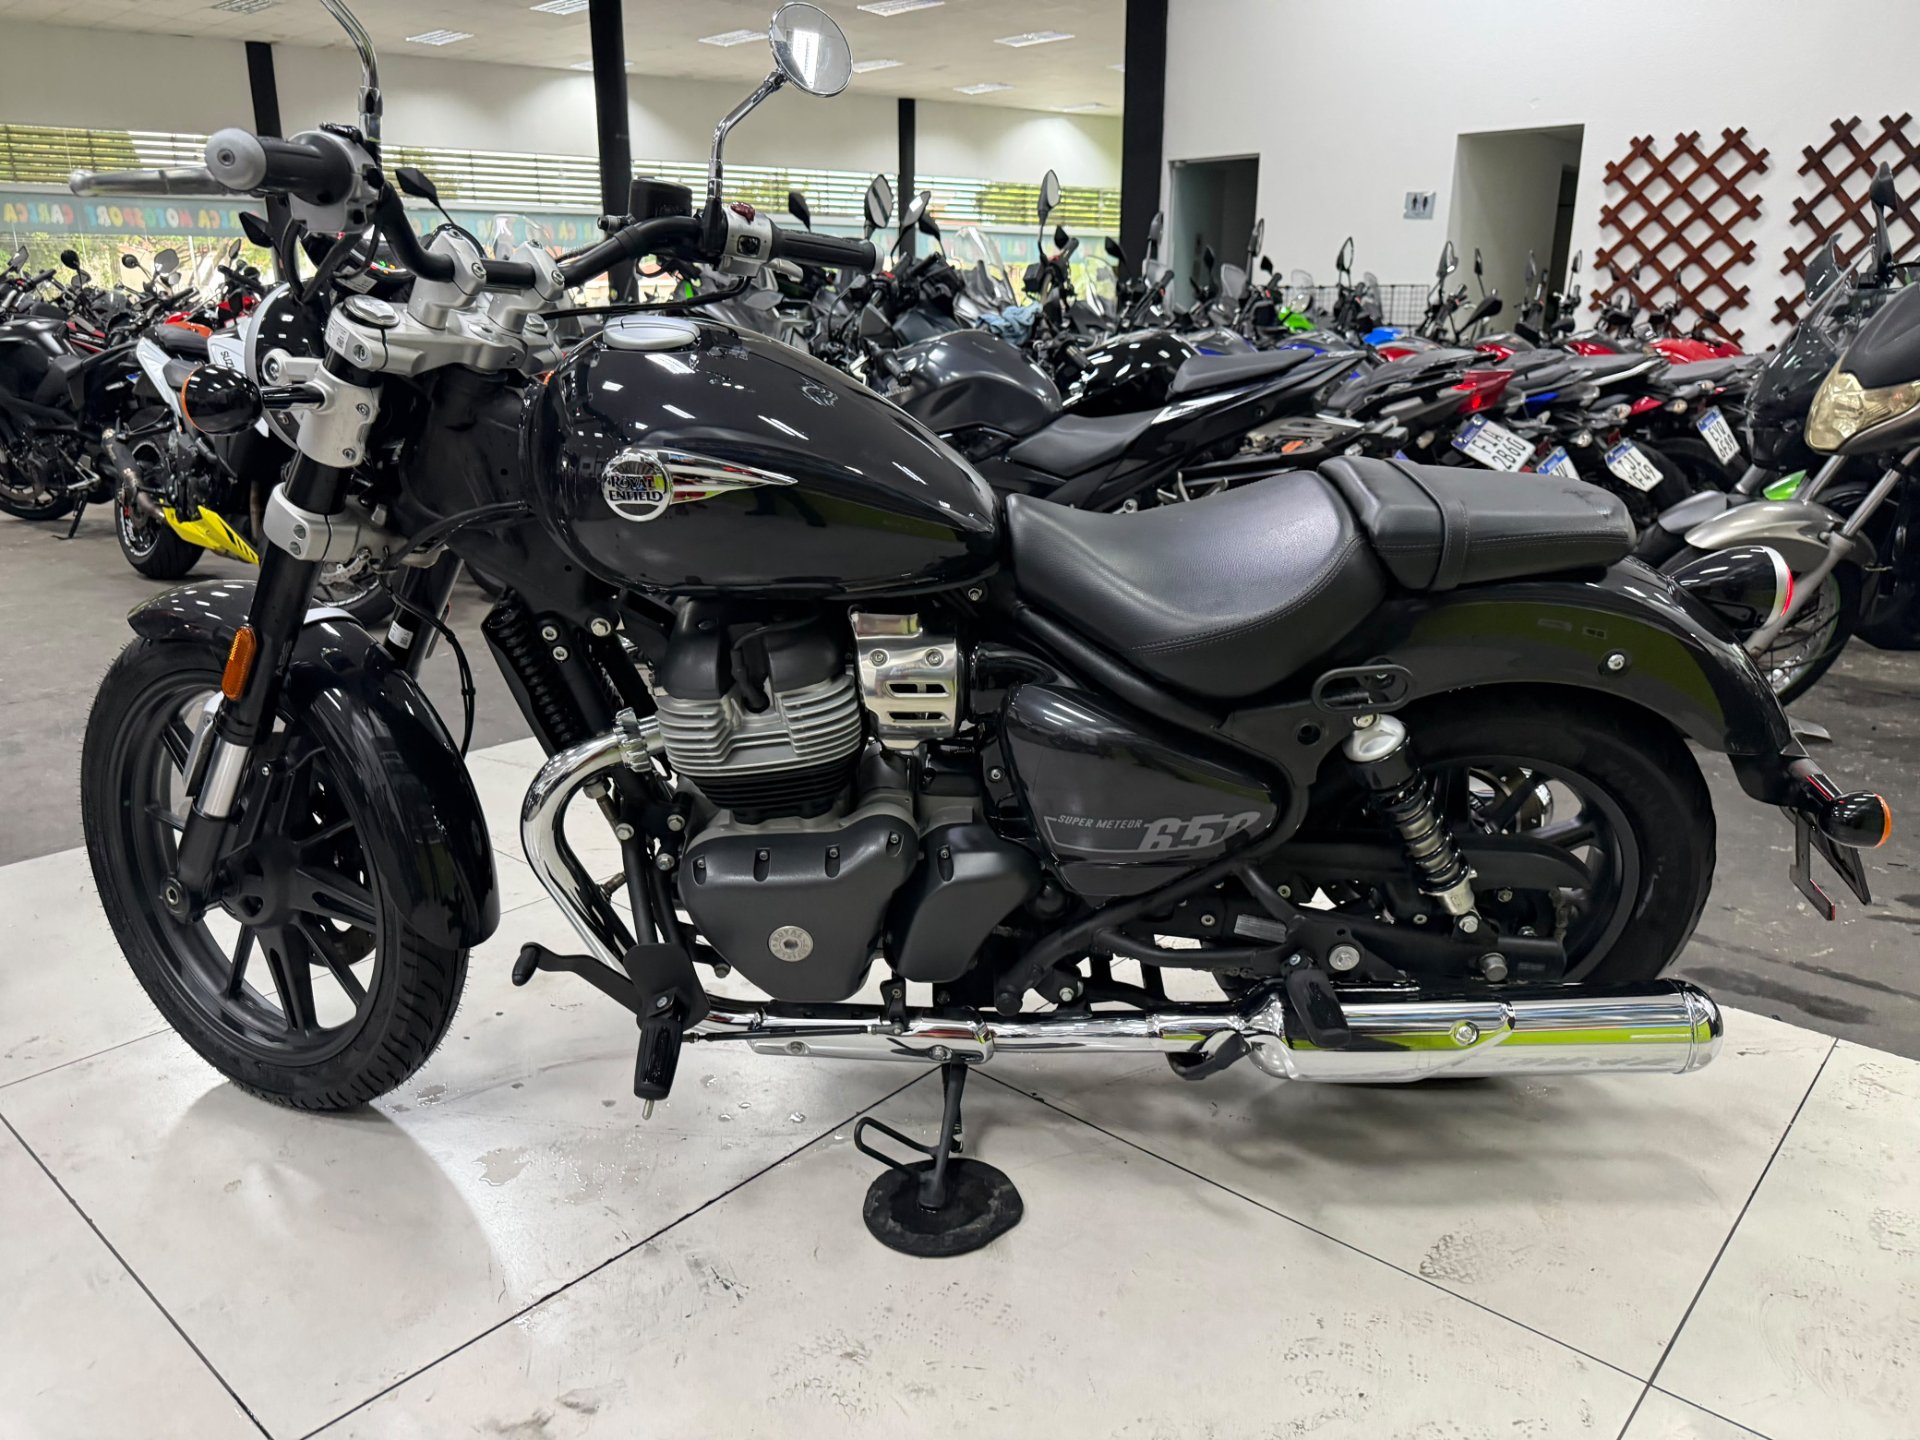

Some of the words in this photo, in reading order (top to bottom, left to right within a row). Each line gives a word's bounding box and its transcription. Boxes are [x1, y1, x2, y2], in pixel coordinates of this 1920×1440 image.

[220, 350, 235, 368] SUZ
[609, 474, 655, 490] ROYAL
[608, 489, 664, 502] ENFIELD
[1057, 814, 1094, 828] SUPER
[1096, 817, 1144, 830] METEOR
